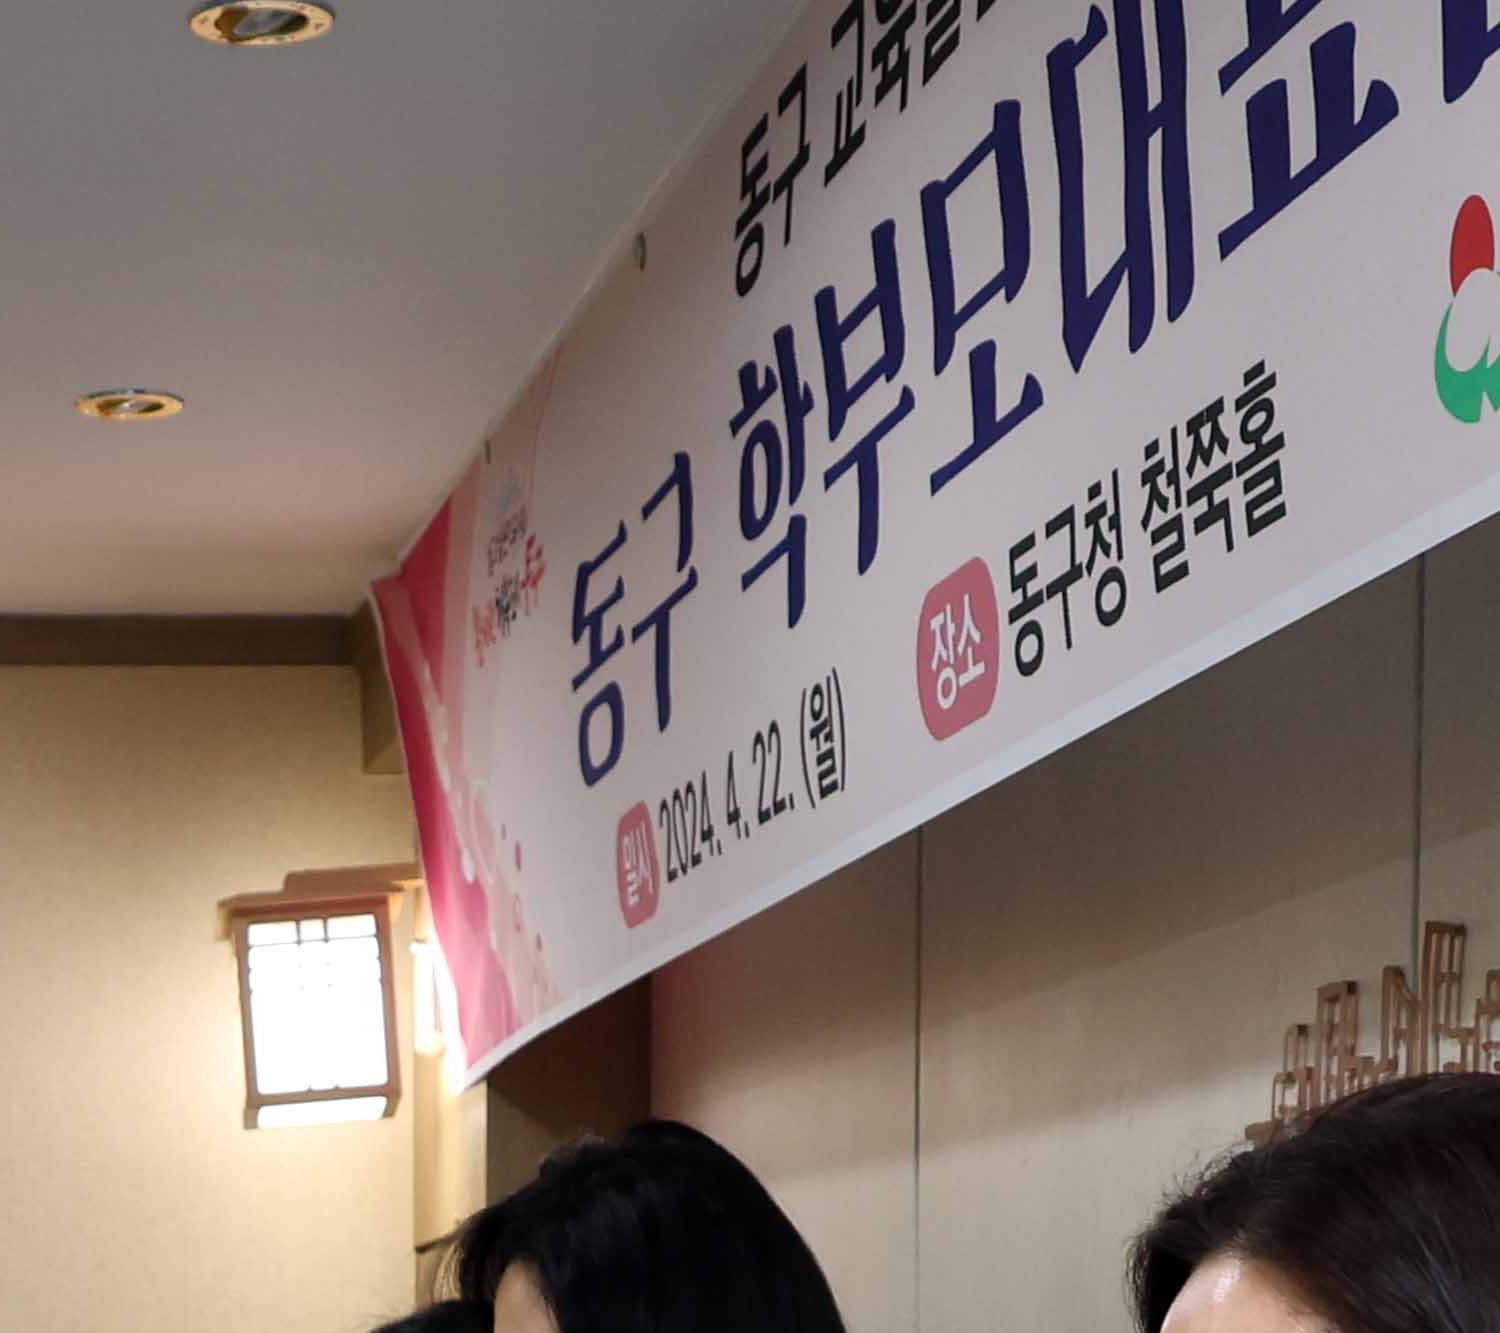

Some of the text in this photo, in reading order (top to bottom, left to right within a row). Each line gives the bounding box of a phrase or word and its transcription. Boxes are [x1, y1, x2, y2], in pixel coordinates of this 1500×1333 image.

[734, 0, 996, 297] 동구 교육
[571, 452, 698, 787] 동구
[928, 359, 1288, 711] 장소 동구청 철쭉홀
[800, 667, 847, 809] (월)
